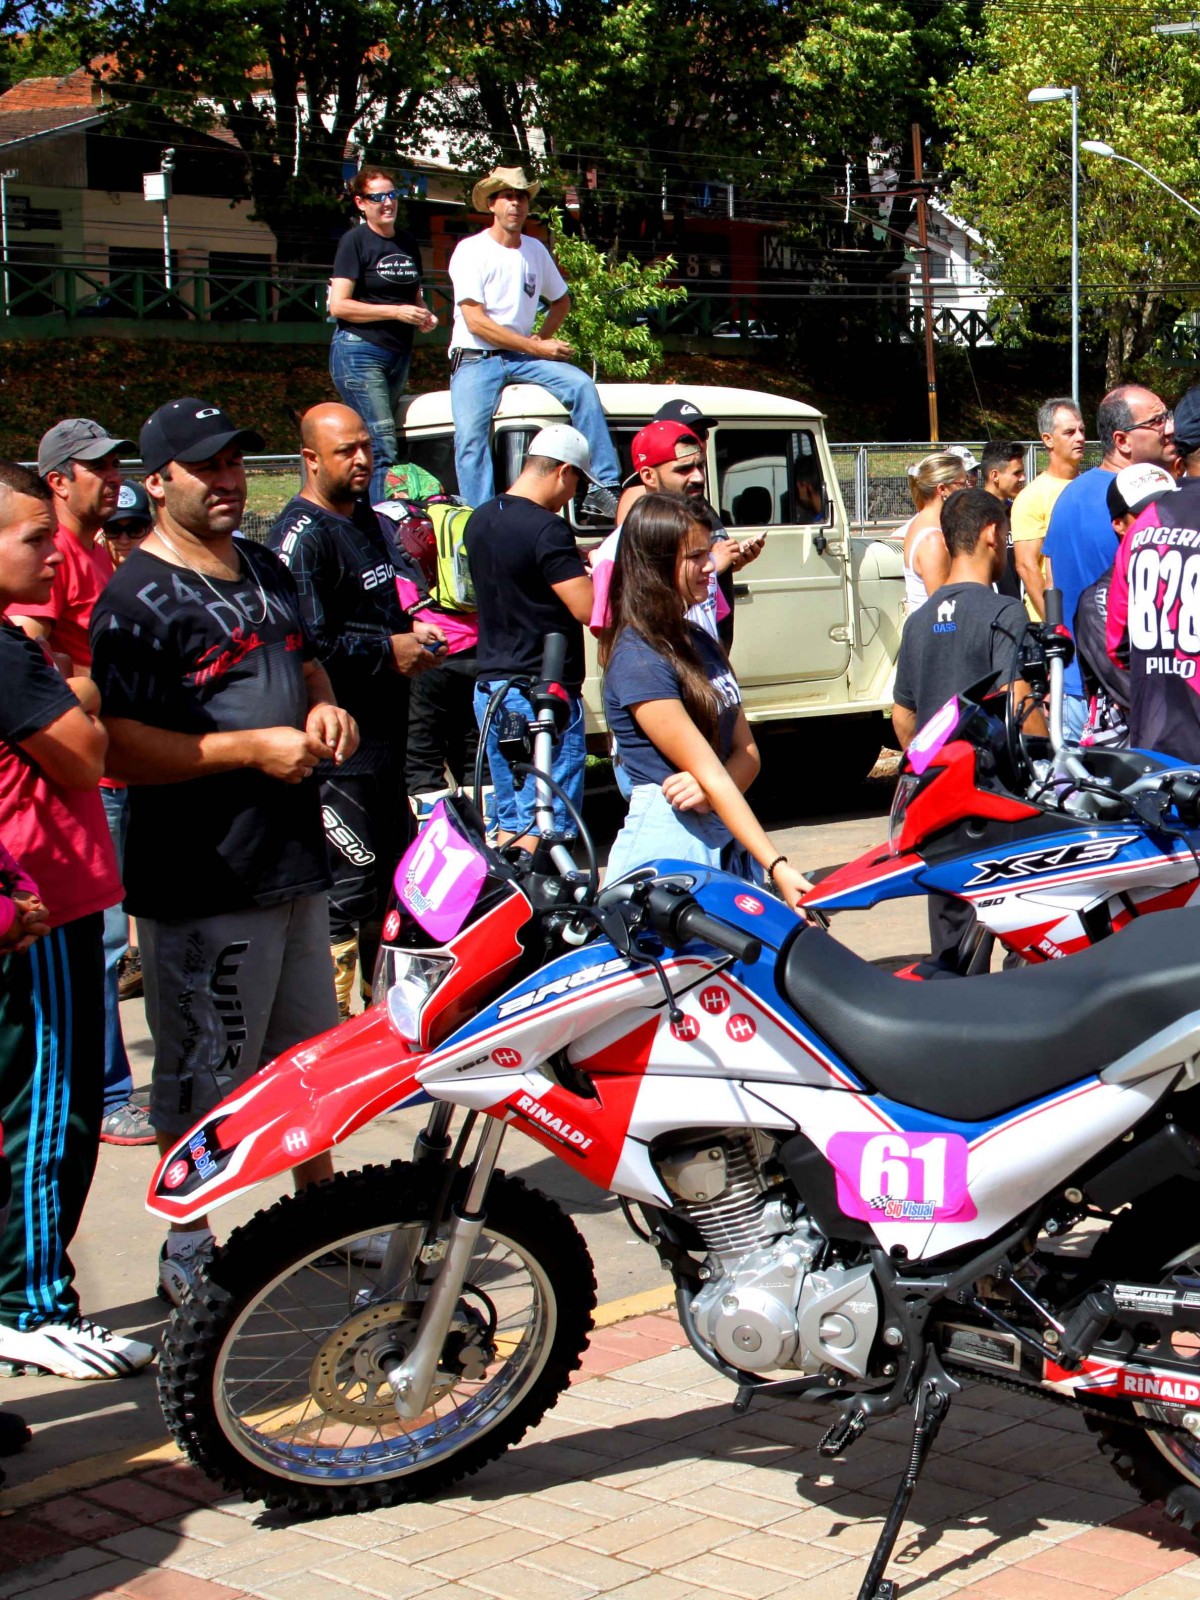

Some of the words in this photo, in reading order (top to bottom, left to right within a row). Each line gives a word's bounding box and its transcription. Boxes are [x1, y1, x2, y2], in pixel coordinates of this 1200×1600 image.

[409, 816, 477, 912] 61
[455, 1054, 489, 1073] 160
[189, 1130, 218, 1180] Mobil
[859, 1134, 948, 1208] 61
